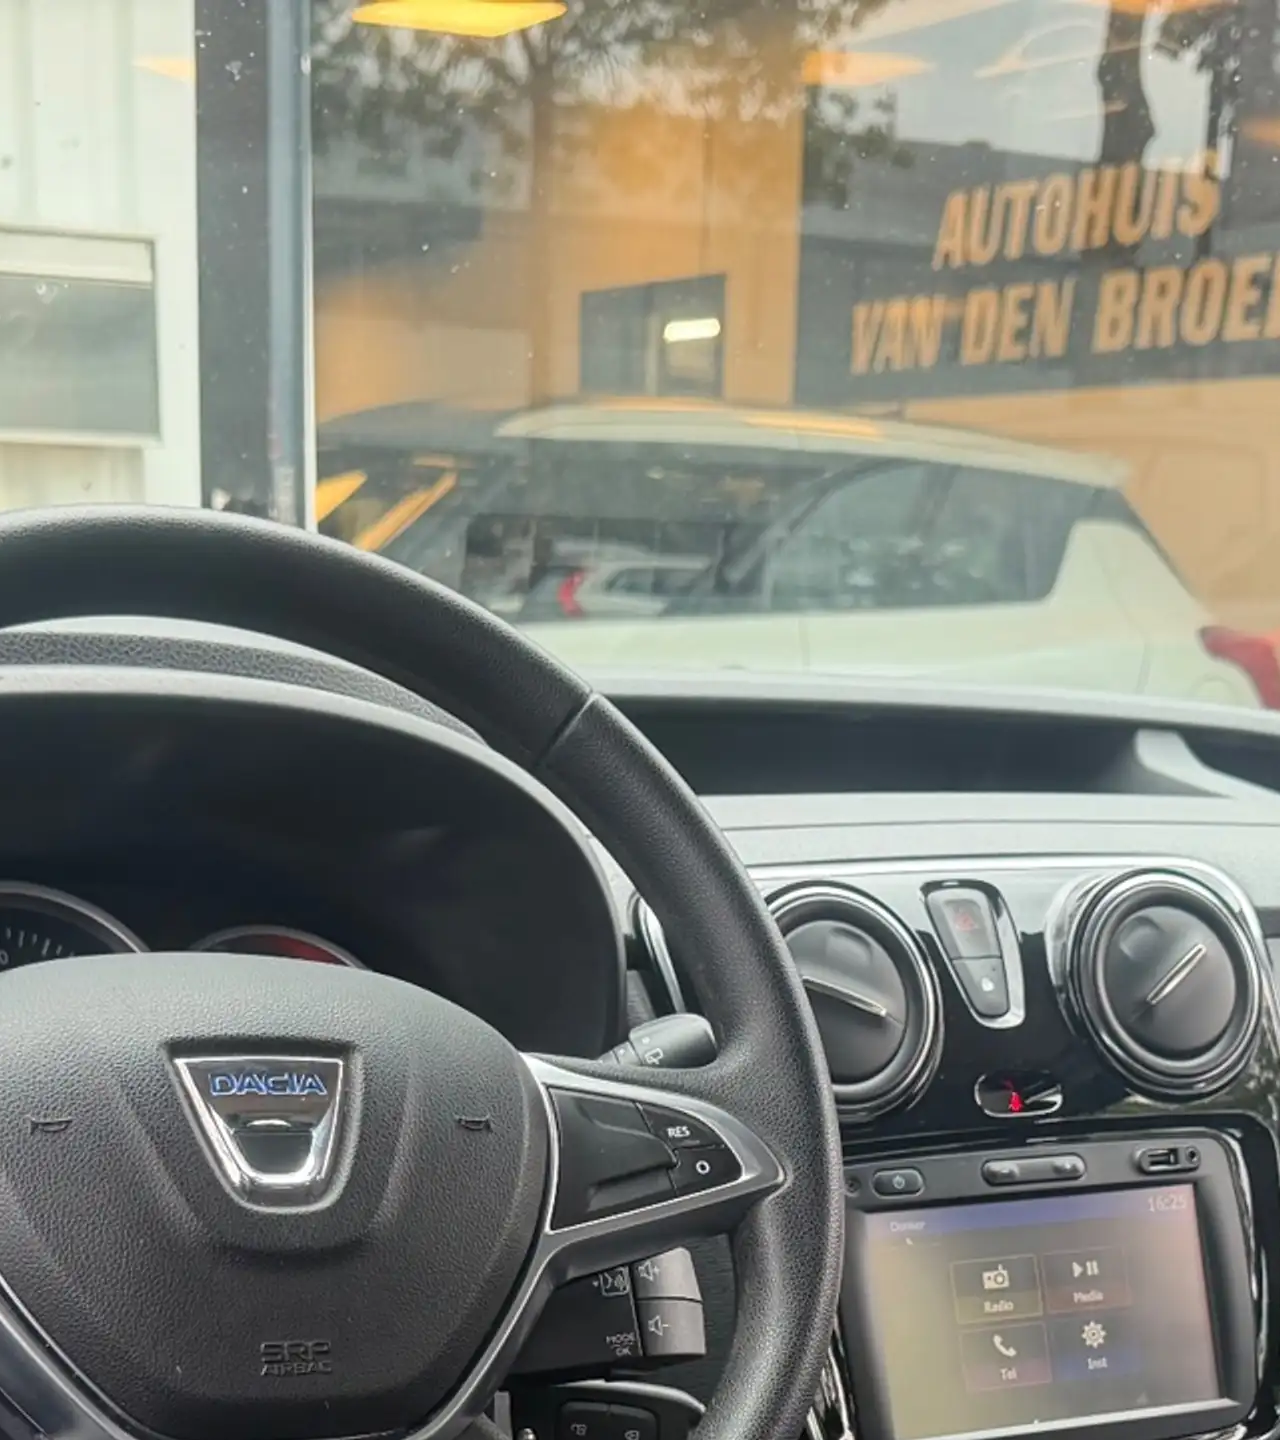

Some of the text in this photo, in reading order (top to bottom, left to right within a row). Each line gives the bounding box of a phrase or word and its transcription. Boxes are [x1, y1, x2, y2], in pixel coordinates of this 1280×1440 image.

[932, 153, 1222, 271] AUTOHUIS
[850, 292, 947, 376] VAN
[959, 277, 1079, 367] DEN
[209, 1071, 327, 1097] DACIA
[667, 1125, 692, 1139] RES
[983, 1297, 1014, 1314] Radio
[999, 1366, 1018, 1382] Tel
